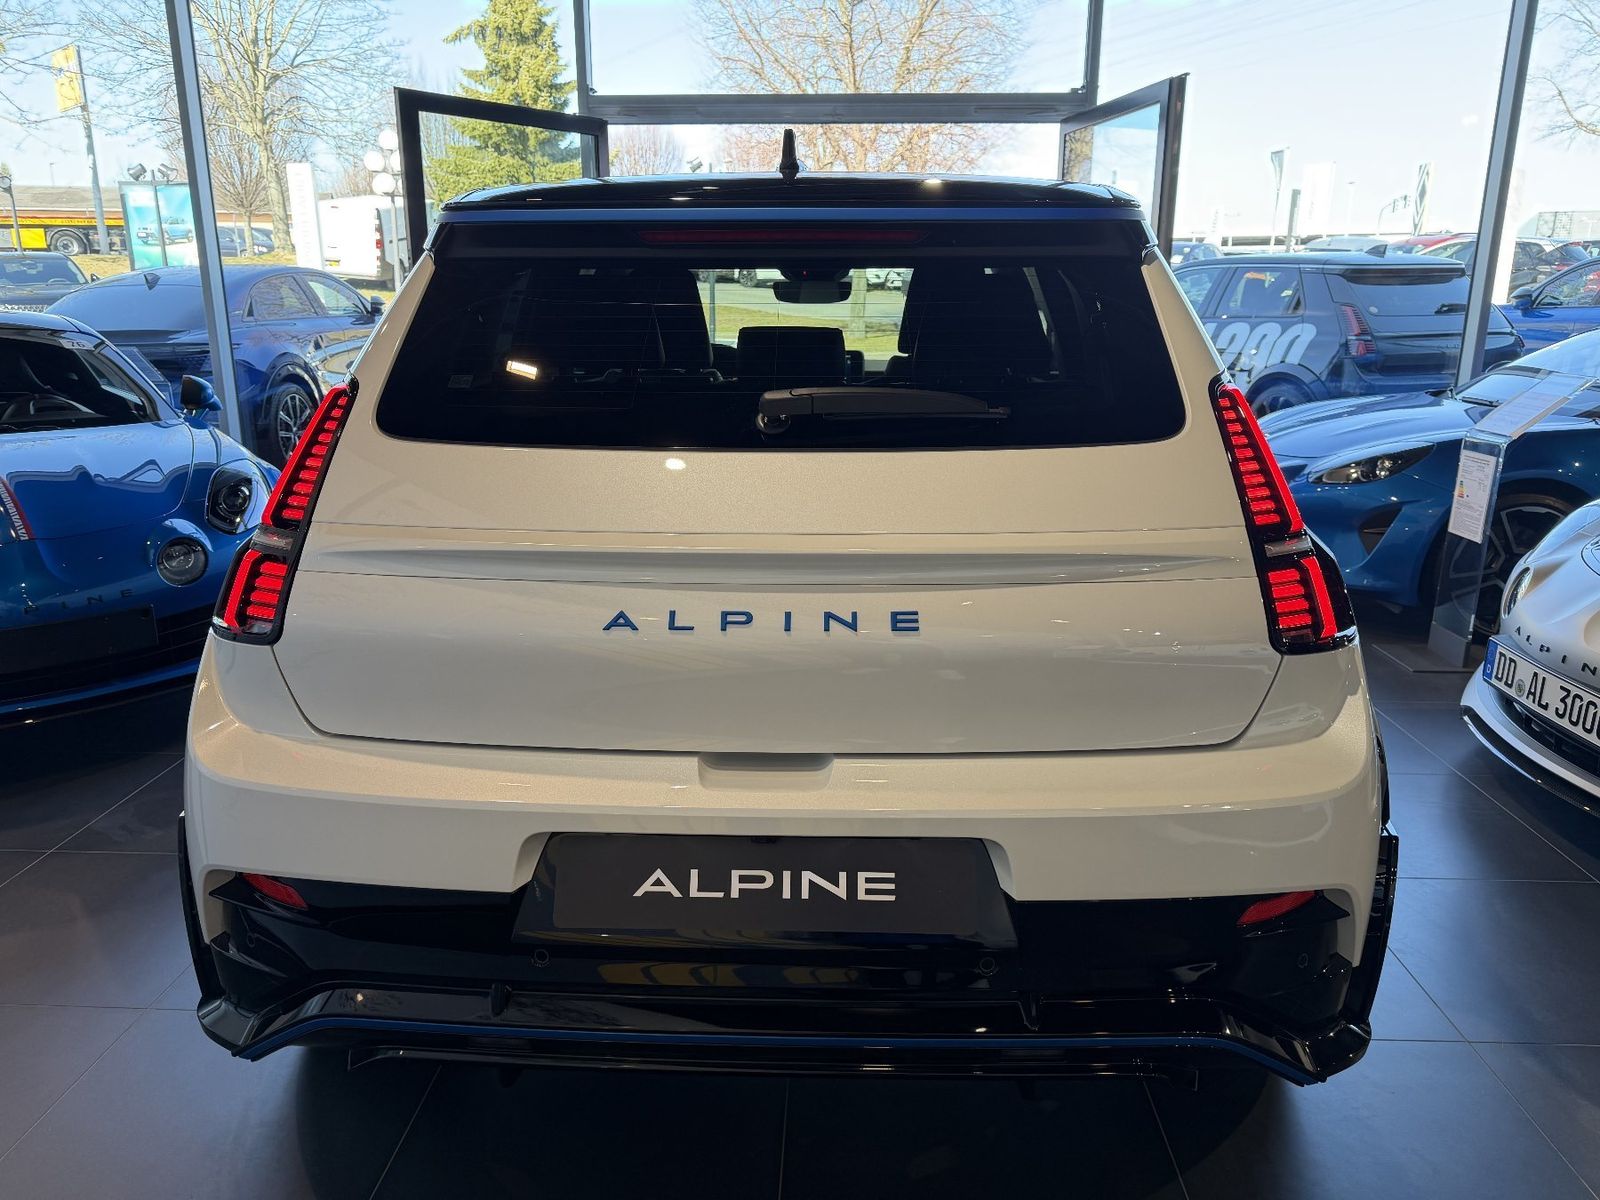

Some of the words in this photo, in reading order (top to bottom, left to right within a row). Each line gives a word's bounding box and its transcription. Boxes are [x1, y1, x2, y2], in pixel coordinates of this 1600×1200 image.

[602, 609, 920, 633] ALPINE
[1494, 650, 1517, 689] DD
[1526, 671, 1549, 711] AL
[1555, 685, 1600, 741] 300
[632, 867, 897, 901] ALPINE
